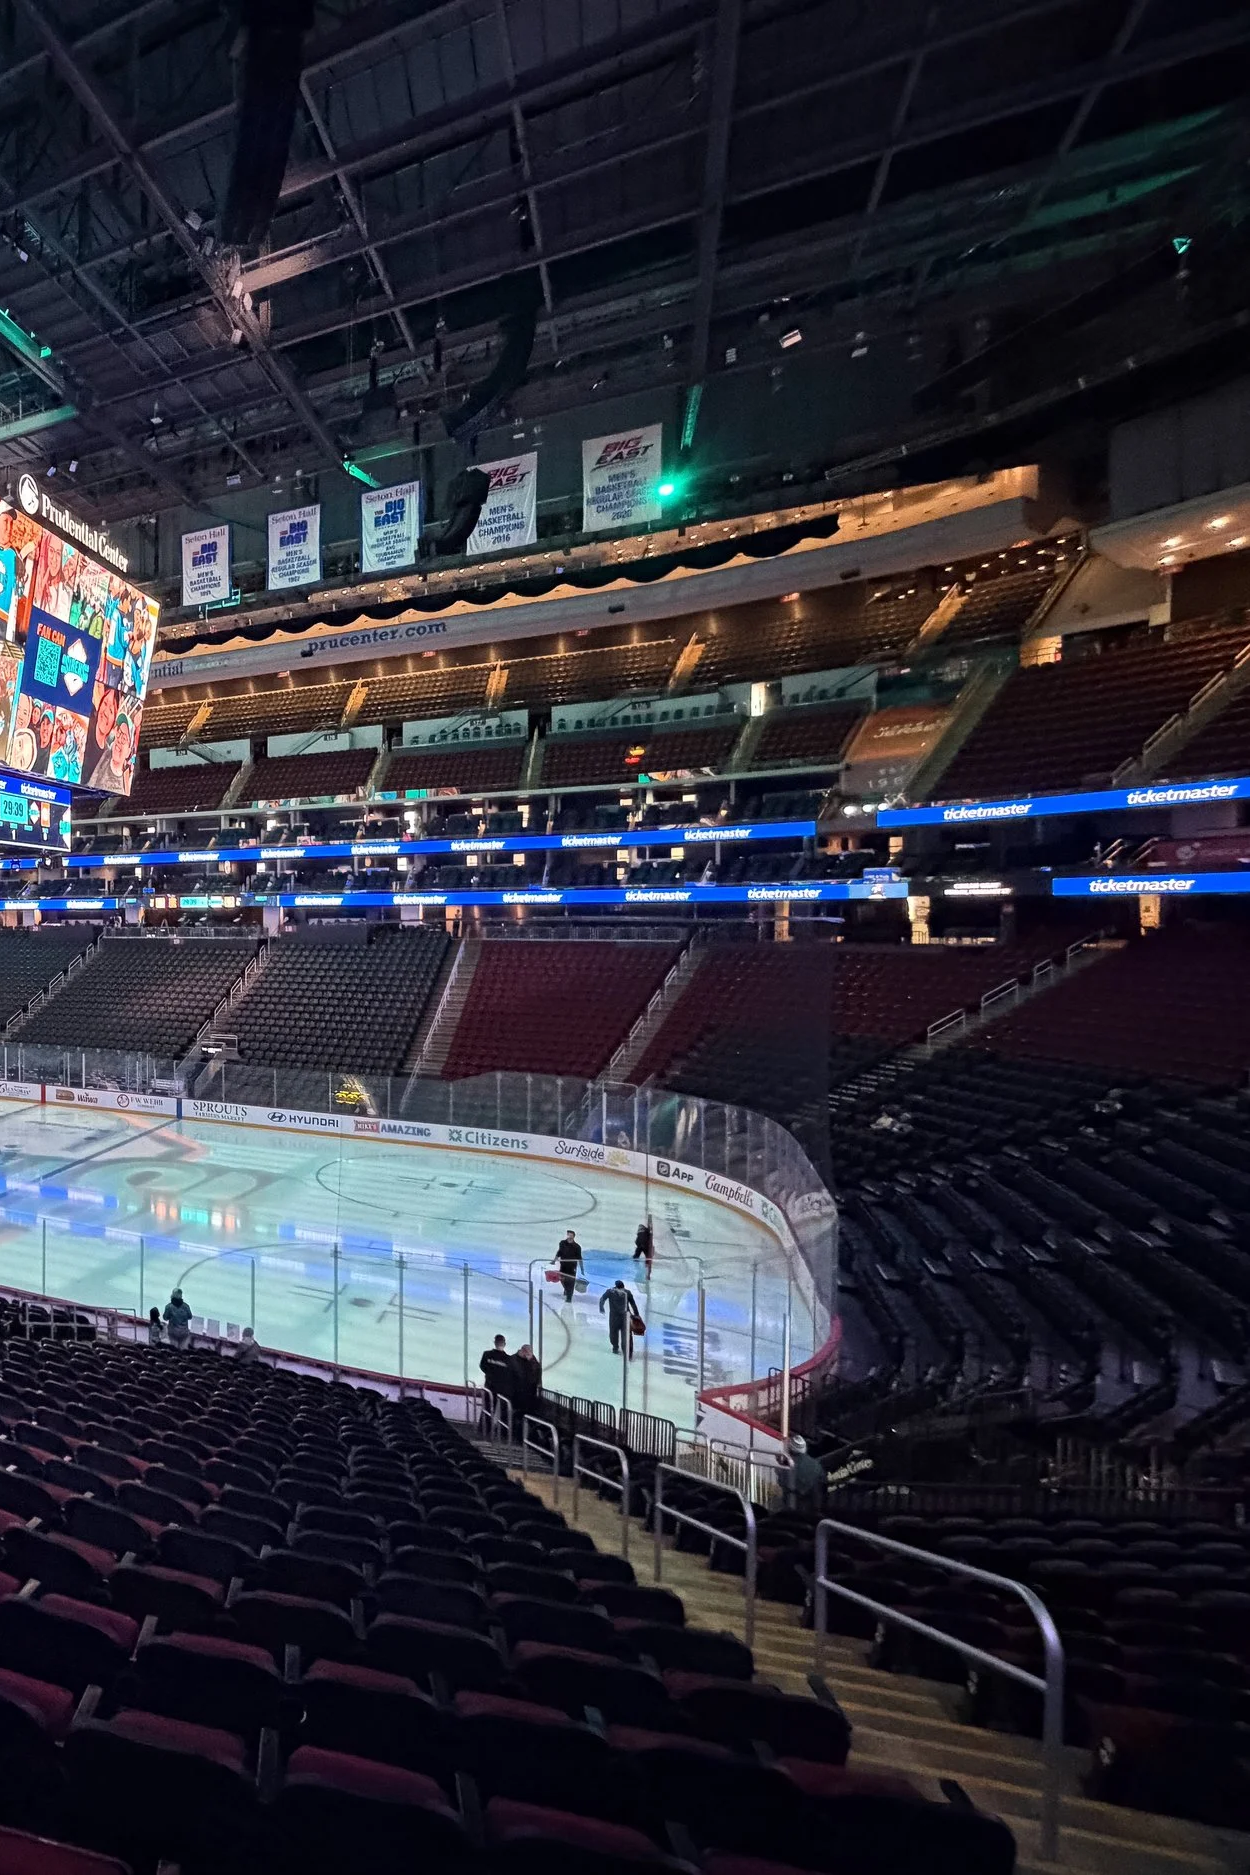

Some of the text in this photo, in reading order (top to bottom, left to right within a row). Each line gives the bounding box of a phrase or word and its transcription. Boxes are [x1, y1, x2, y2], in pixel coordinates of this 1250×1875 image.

[602, 435, 643, 454] BIG
[595, 444, 654, 465] EAST
[490, 470, 532, 488] AST
[366, 485, 415, 503] Seton Hall
[385, 498, 405, 513] BIG
[490, 504, 514, 515] MEN'S
[272, 507, 317, 524] Seton Hall
[374, 510, 405, 527] EAST
[478, 511, 526, 527] BASKETBALL
[42, 493, 99, 554] Prudential
[99, 535, 129, 573] Center
[289, 520, 308, 534] BIG
[479, 521, 525, 537] CHAMPIONS
[185, 528, 225, 544] Seton Hall
[280, 531, 308, 547] EAST
[491, 534, 510, 545] 2016
[201, 541, 217, 554] BIG
[192, 552, 218, 567] EAST
[37, 623, 66, 647] FAN CAM
[308, 621, 447, 652] prucenter.com
[21, 783, 57, 799] ticketmaster
[1126, 784, 1238, 805] ticketmaster
[3, 800, 24, 816] 29:39
[943, 802, 1032, 821] ticketmaster
[561, 835, 623, 847] ticketmaster
[684, 827, 752, 841] ticketmaster
[451, 840, 505, 850] ticketmaster
[747, 887, 822, 900] ticketmaster
[1089, 878, 1195, 893] ticketmaster
[502, 893, 563, 904] ticketmaster
[625, 890, 692, 902] ticketmaster
[77, 1092, 98, 1104] Wawa
[193, 1101, 248, 1117] SPROUTS
[289, 1114, 339, 1128] HYUNDAI
[381, 1124, 431, 1137] AMAZING
[464, 1131, 528, 1150] Citizens
[554, 1140, 604, 1162] Surfside
[705, 1173, 753, 1208] Campbell's
